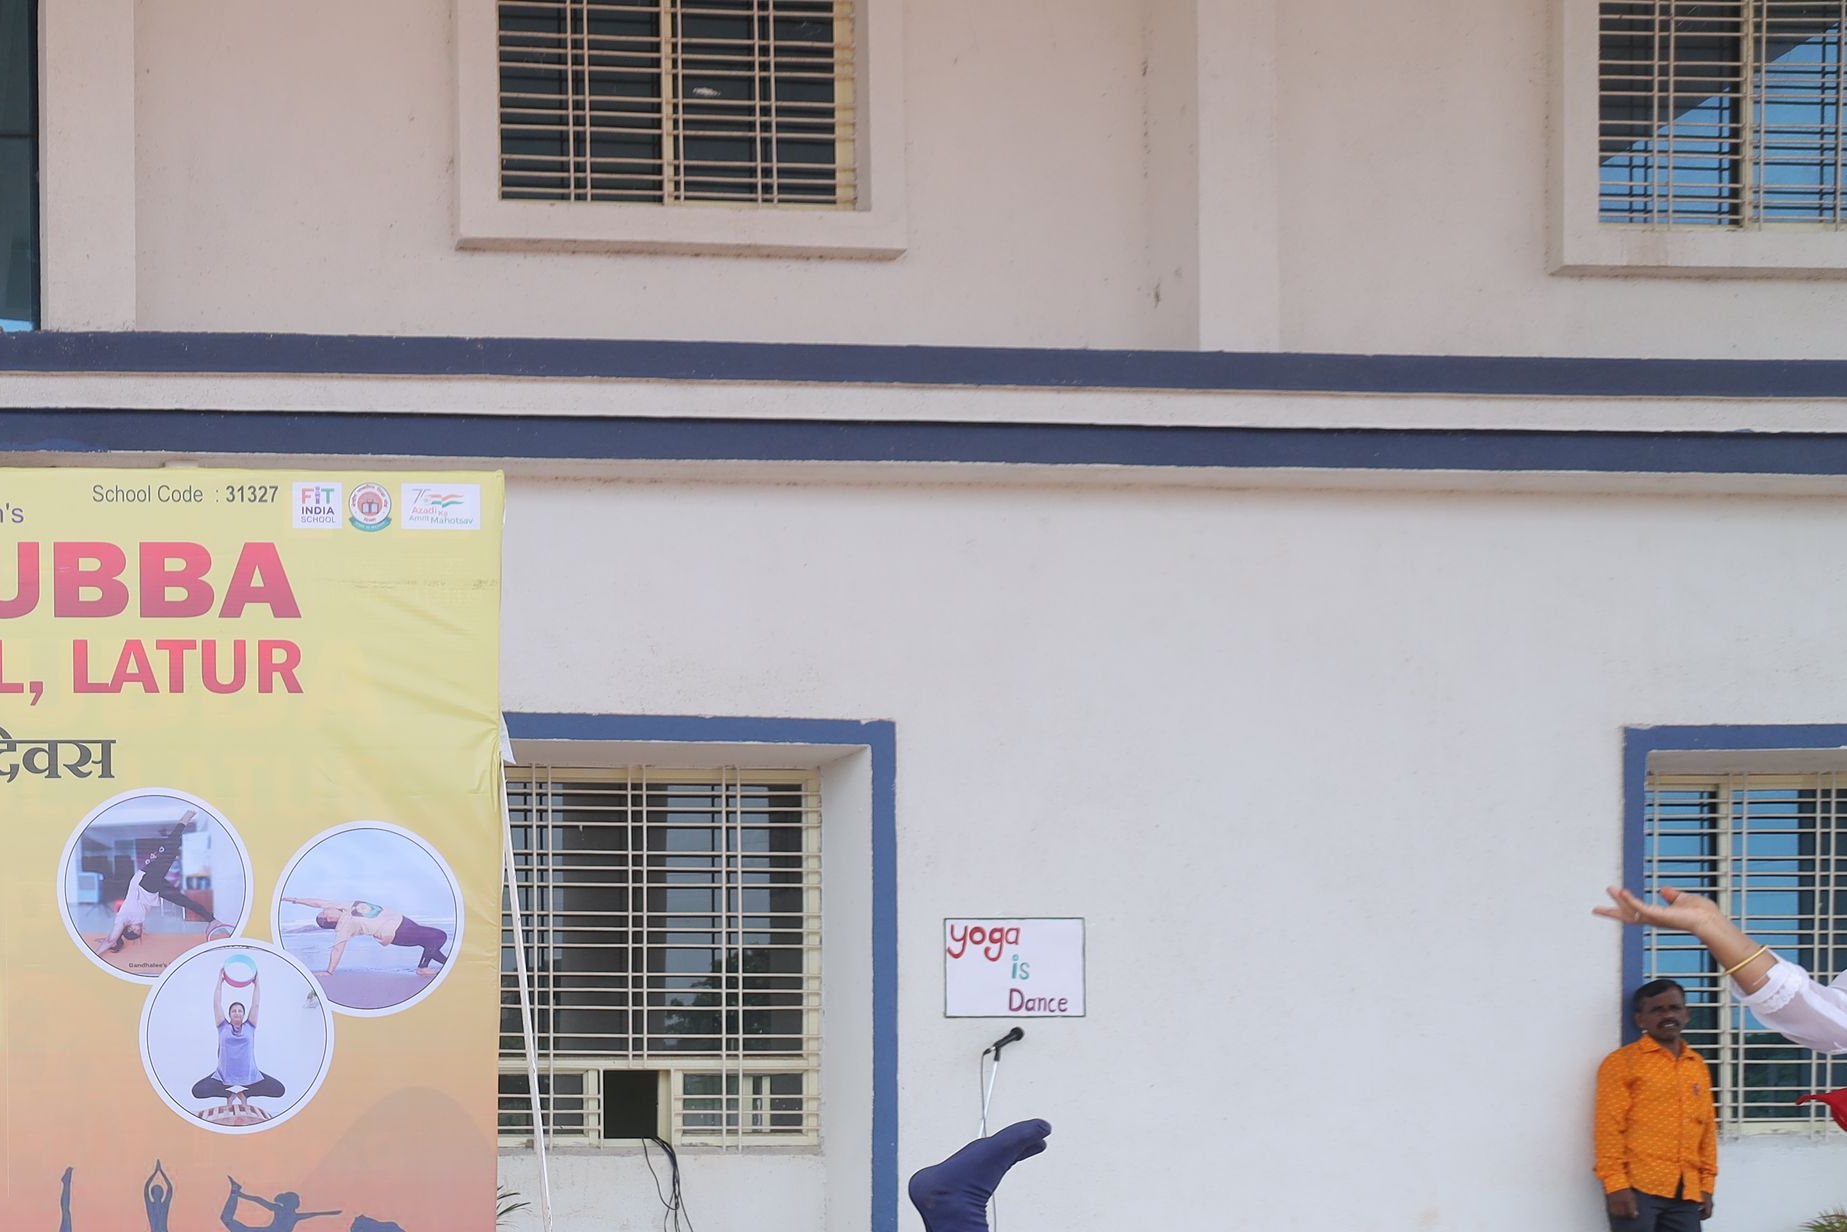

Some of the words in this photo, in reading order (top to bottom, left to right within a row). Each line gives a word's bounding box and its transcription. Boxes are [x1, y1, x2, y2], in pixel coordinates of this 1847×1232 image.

[92, 484, 152, 503] School
[158, 484, 204, 503] Code
[225, 484, 279, 503] 31327
[300, 516, 336, 524] SCHOOL
[301, 506, 335, 516] INDIA
[411, 506, 438, 515] Azadi
[72, 638, 304, 695] LATUR
[947, 923, 1021, 962] yoga
[1011, 953, 1030, 980] is
[1008, 988, 1069, 1013] Dance
